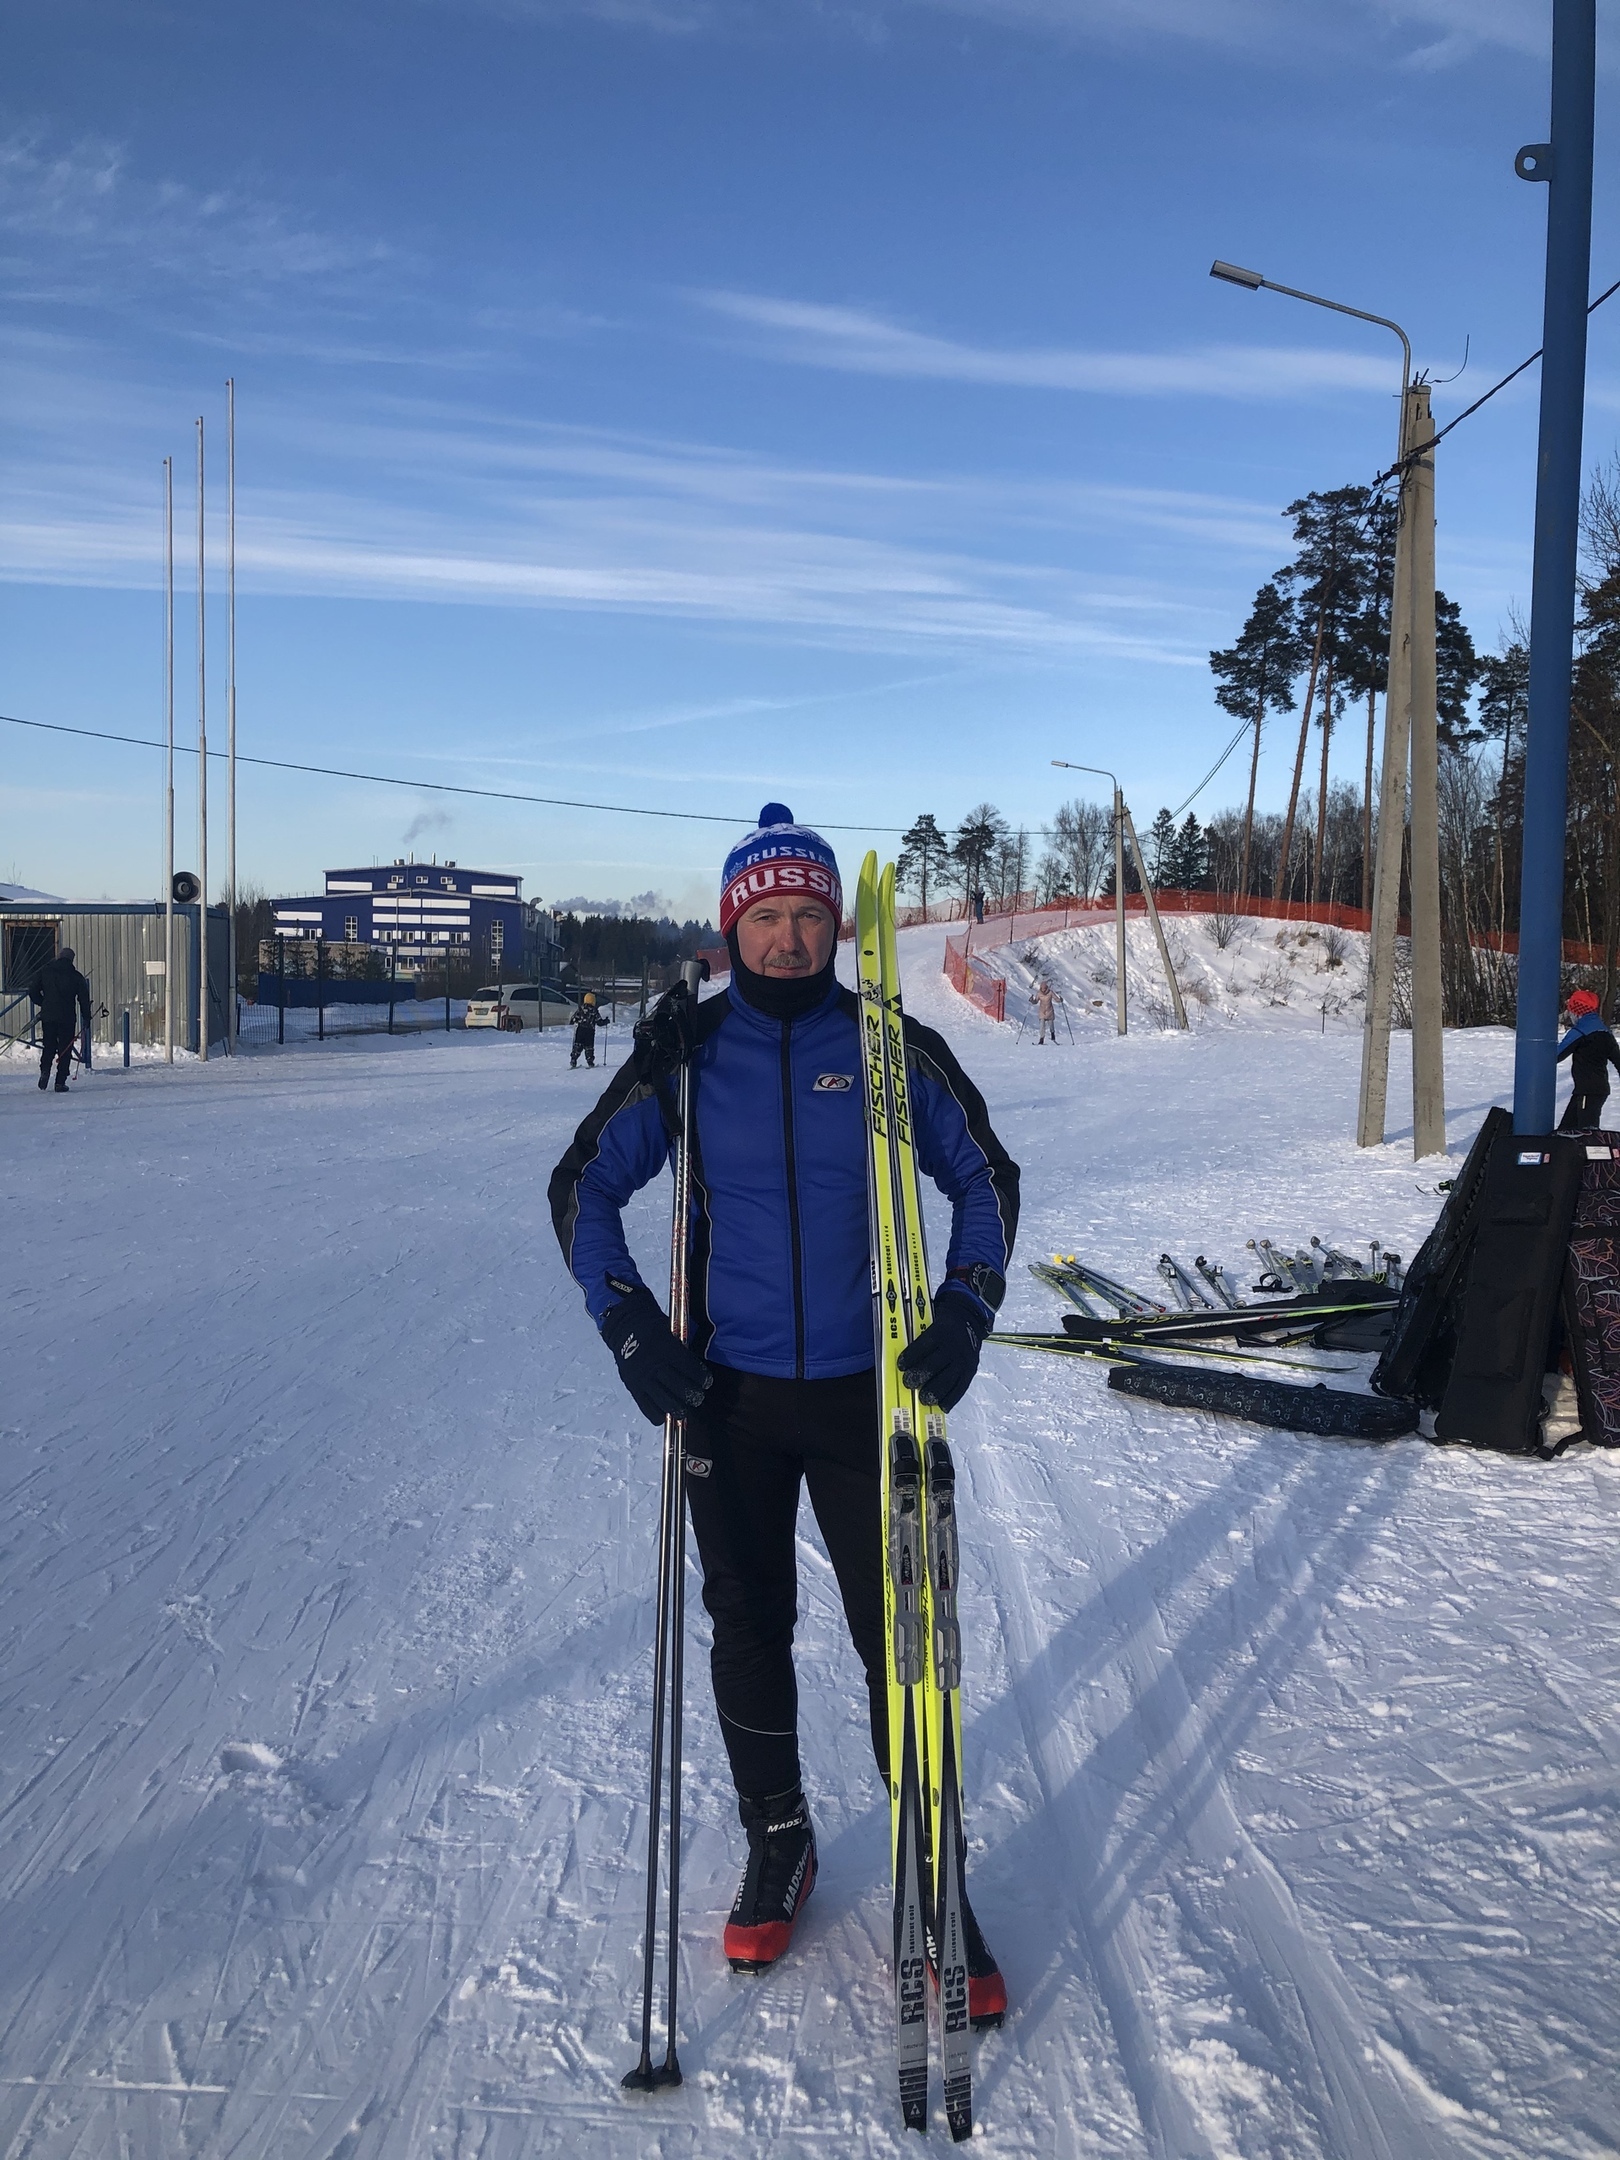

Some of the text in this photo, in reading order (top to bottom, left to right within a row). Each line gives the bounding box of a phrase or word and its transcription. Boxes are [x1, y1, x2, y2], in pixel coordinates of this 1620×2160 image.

[746, 846, 829, 866] RUSSIA
[867, 1014, 887, 1139] FISCHER
[888, 1024, 910, 1146] FISCHER
[890, 1316, 898, 1340] RCS
[900, 1957, 925, 2025] RCS
[944, 1964, 967, 2034] RCS
